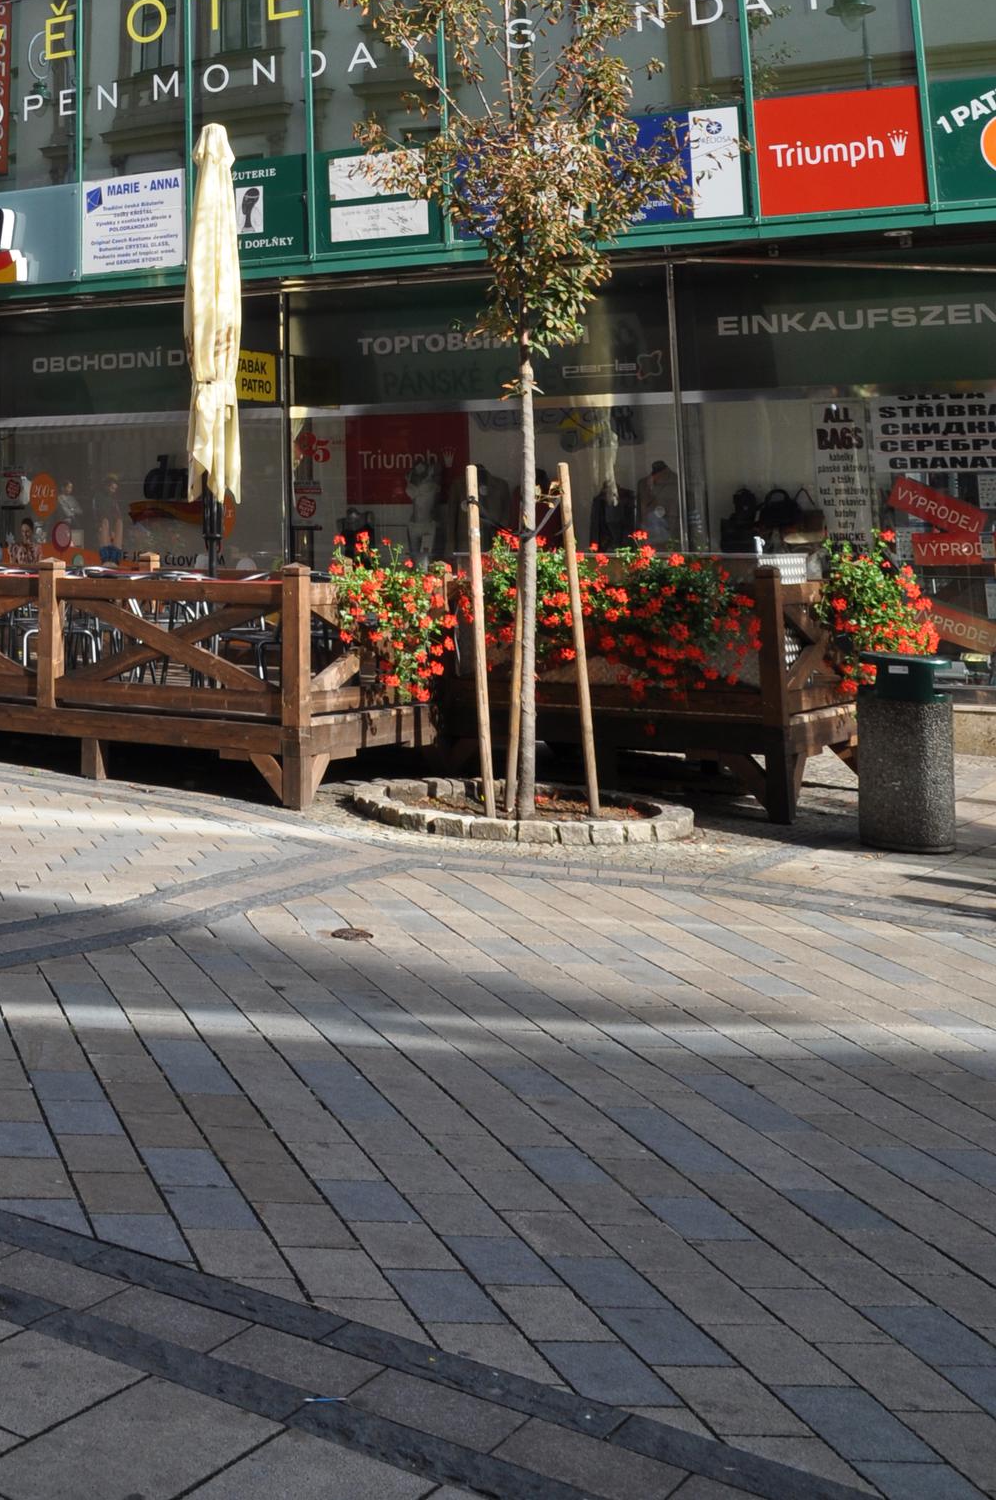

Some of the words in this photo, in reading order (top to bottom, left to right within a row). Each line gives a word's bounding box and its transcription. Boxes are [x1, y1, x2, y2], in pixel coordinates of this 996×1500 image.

[936, 116, 953, 134] 1
[769, 136, 885, 168] Triumph
[107, 182, 141, 197] MARIE
[150, 177, 180, 192] ANNA
[245, 237, 294, 250] DOPLŇKY
[32, 347, 163, 374] OBCHODNÍ
[241, 378, 272, 394] PATRO
[823, 405, 854, 424] ALL
[816, 427, 864, 451] BAGS
[897, 485, 980, 534] VÝPRODEJ
